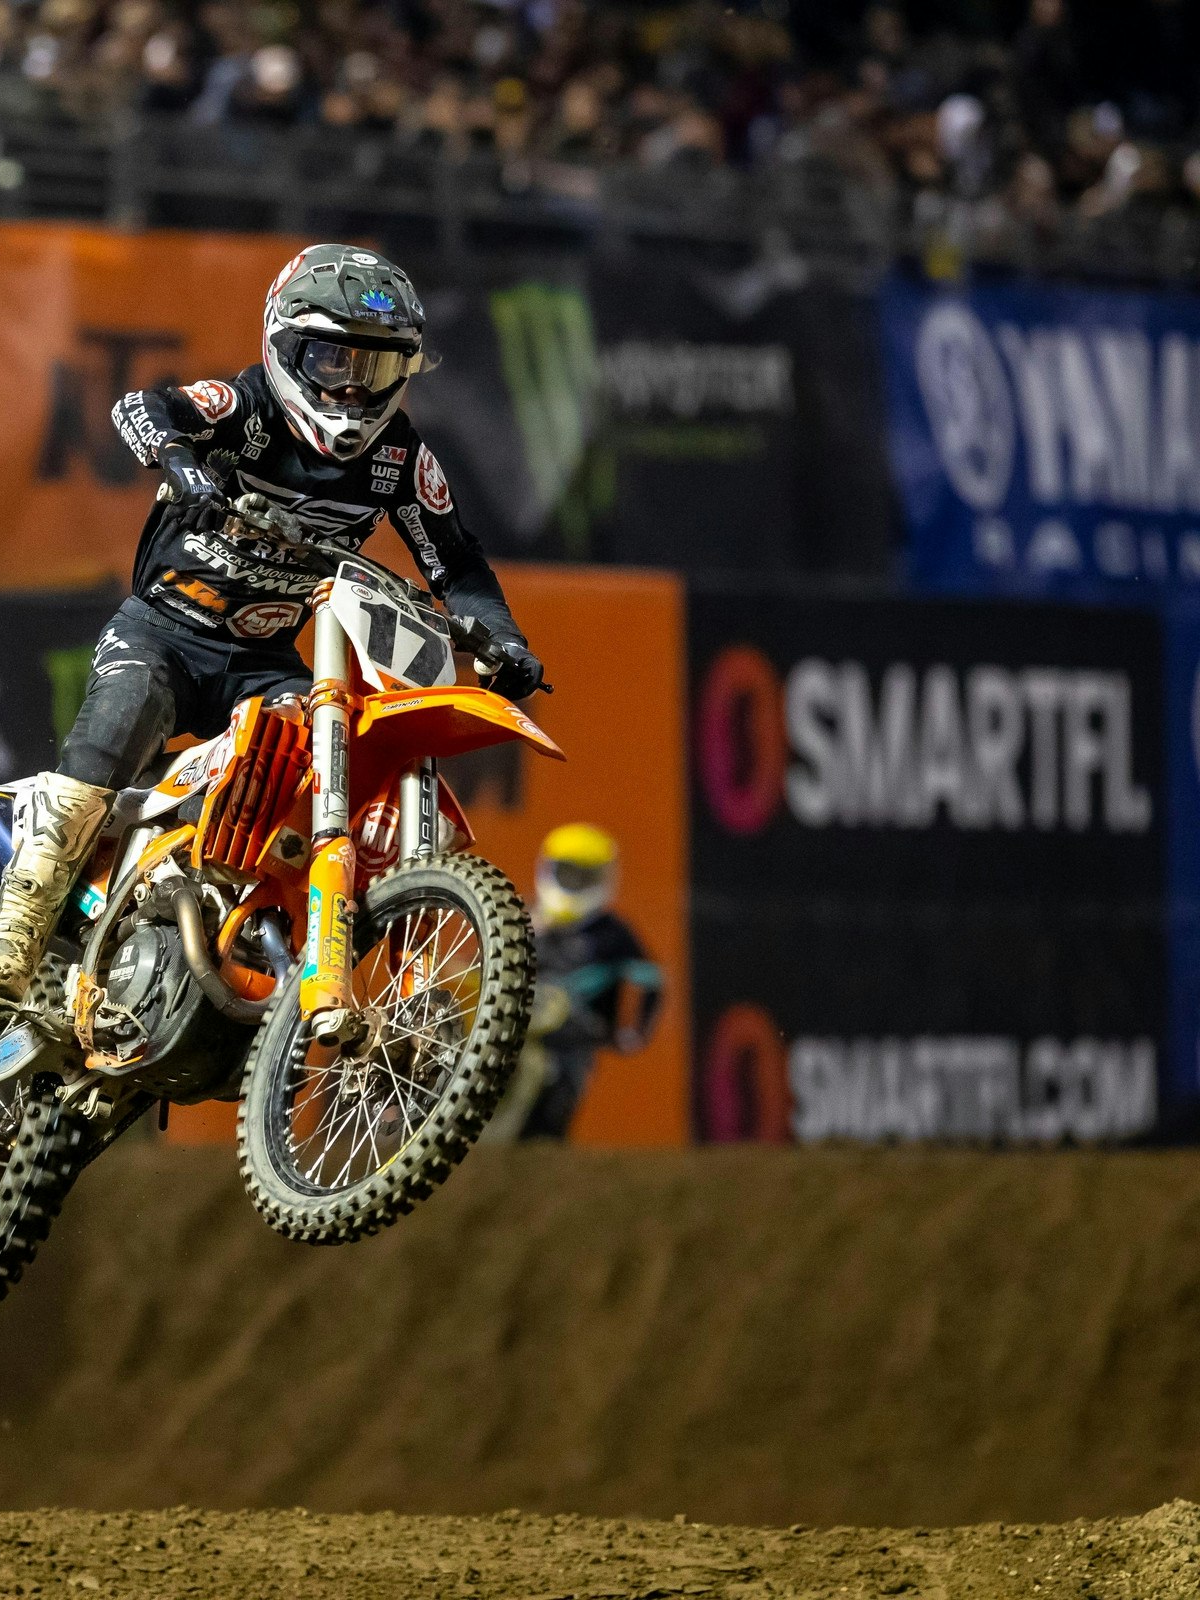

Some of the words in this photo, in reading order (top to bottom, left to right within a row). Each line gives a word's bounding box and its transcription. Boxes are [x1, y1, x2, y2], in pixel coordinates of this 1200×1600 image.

[181, 467, 211, 486] FL
[208, 540, 251, 568] ROCKY
[359, 601, 448, 689] 17
[785, 655, 1153, 834] SMARTFL
